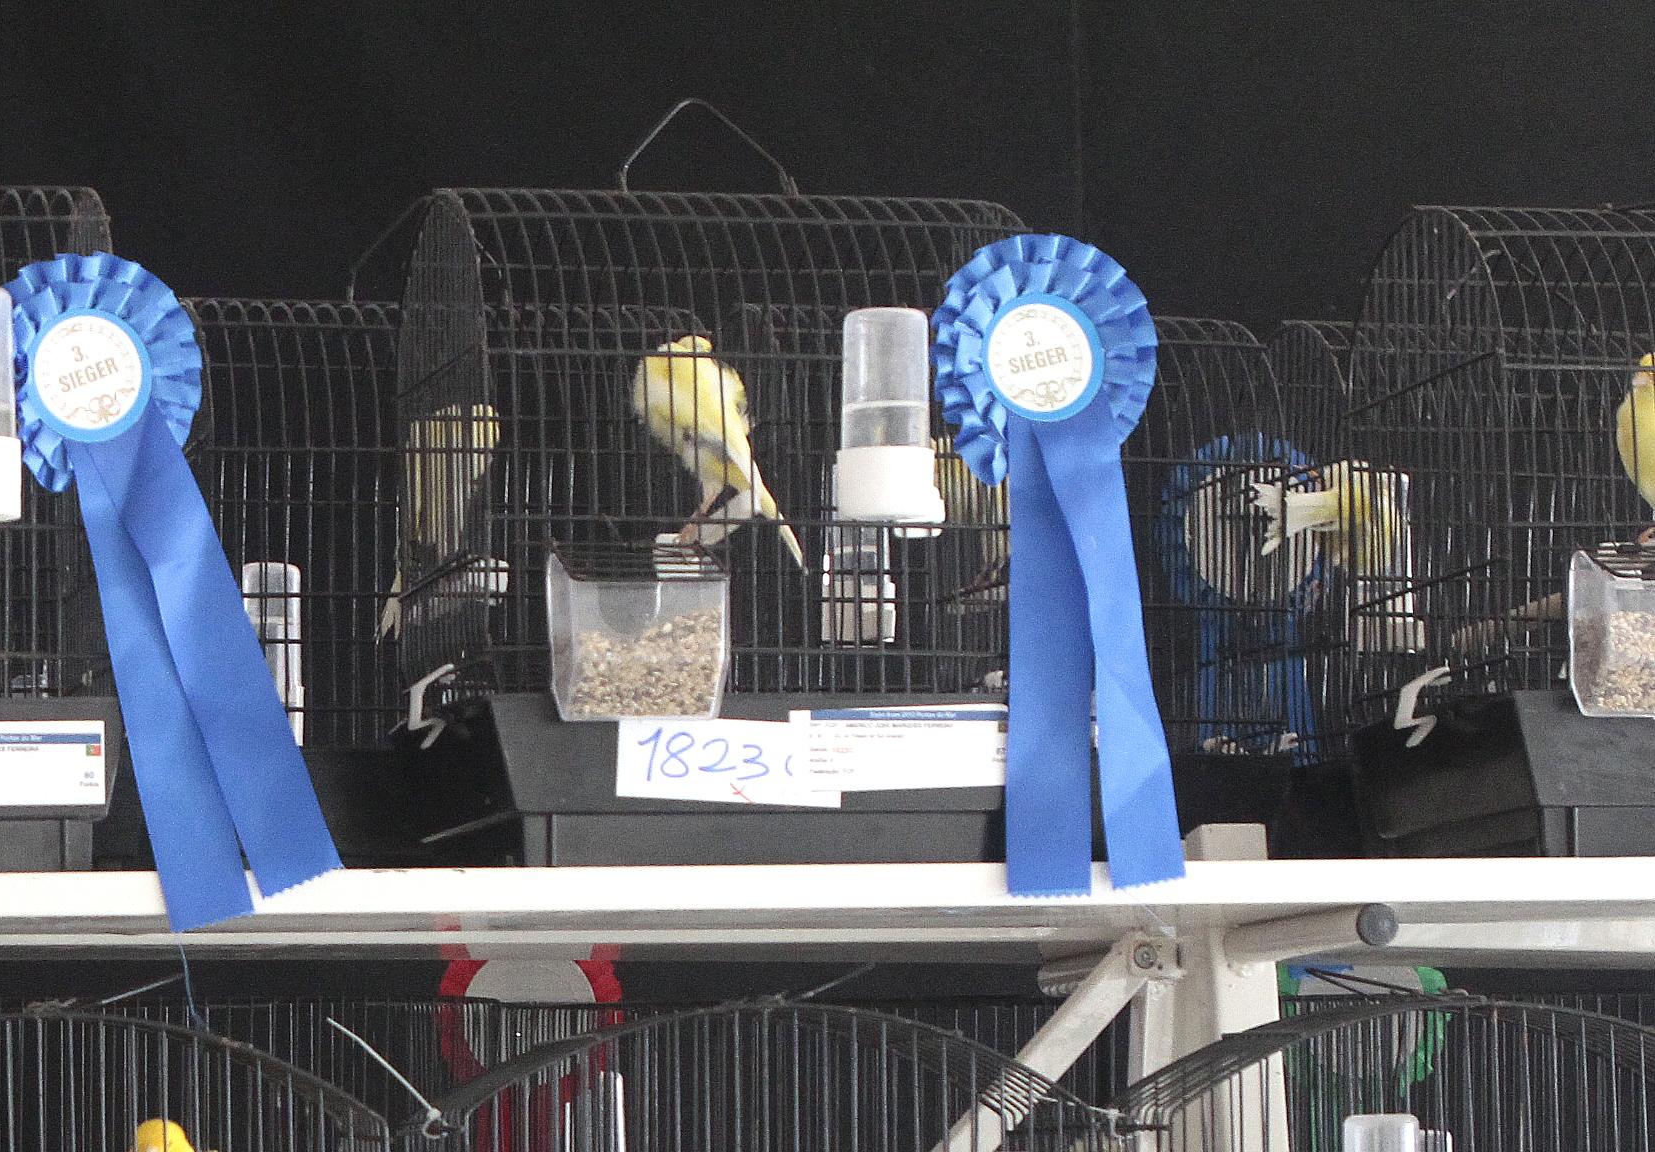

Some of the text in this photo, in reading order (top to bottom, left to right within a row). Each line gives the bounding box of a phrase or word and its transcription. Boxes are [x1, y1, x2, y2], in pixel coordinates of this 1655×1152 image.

[57, 356, 119, 393] SIEGER
[1007, 346, 1069, 375] SIEGER
[637, 727, 769, 781] 1823
